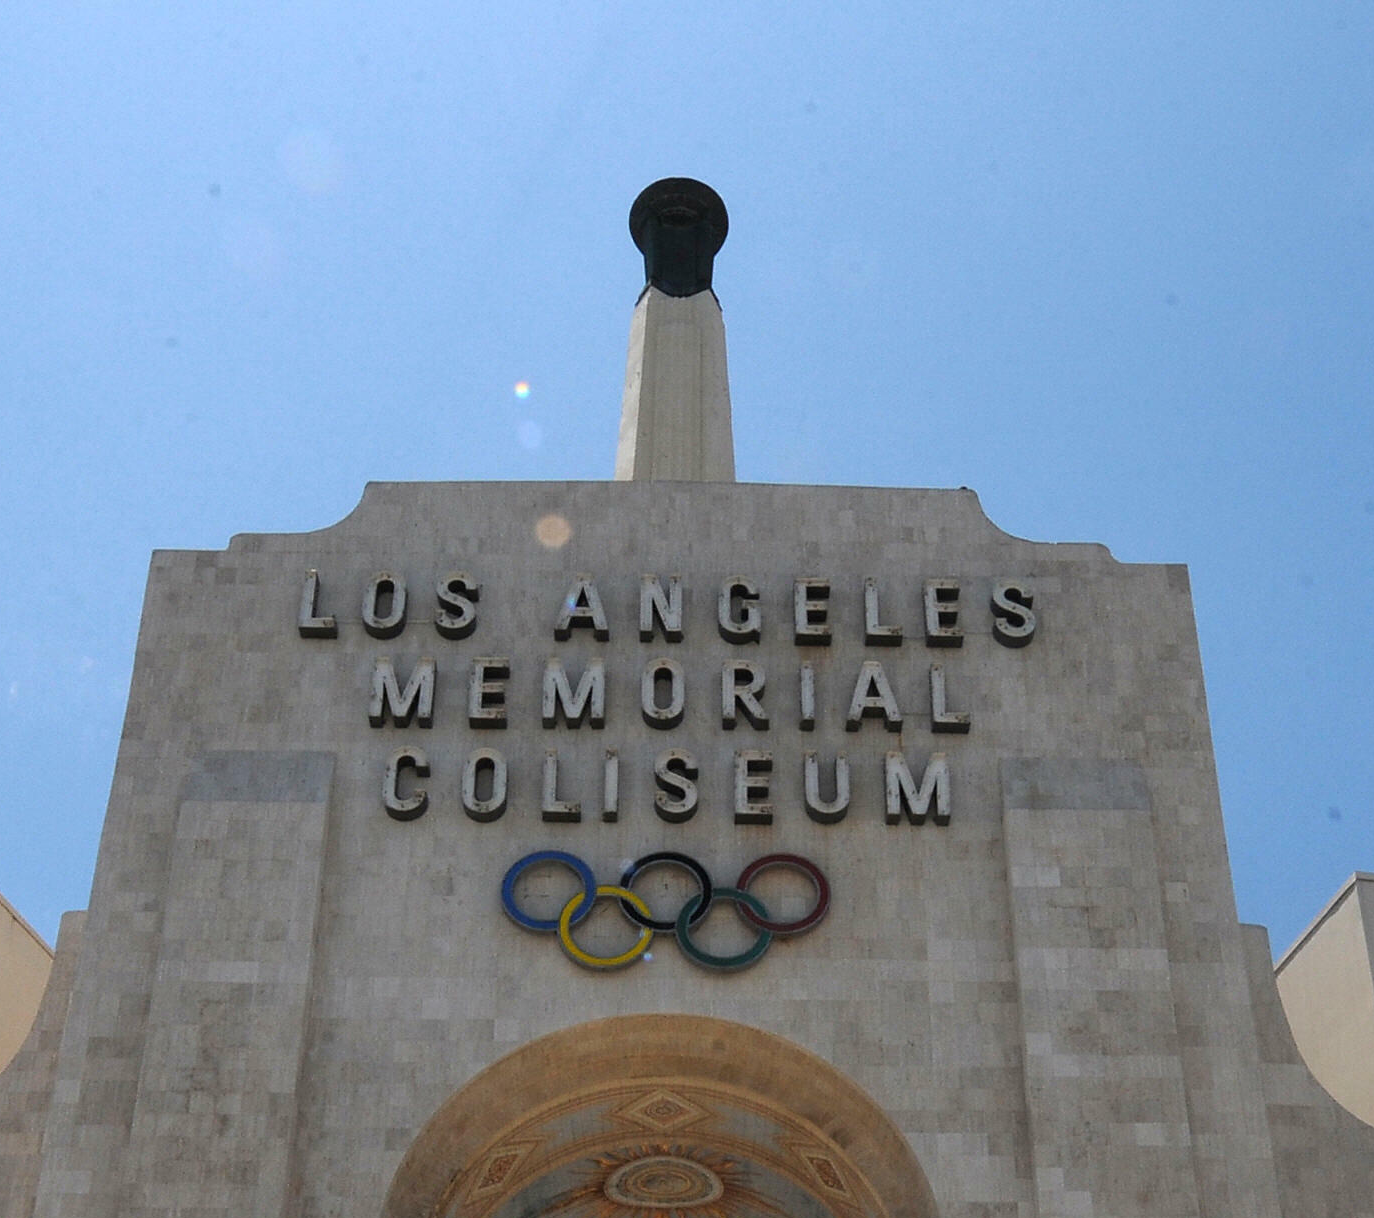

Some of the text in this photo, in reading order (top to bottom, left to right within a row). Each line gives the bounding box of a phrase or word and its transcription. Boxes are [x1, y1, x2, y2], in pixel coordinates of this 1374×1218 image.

[298, 569, 1037, 649] LOS ANGELES
[368, 657, 971, 734] MEMORIAL
[383, 747, 952, 827] COLISEUM
